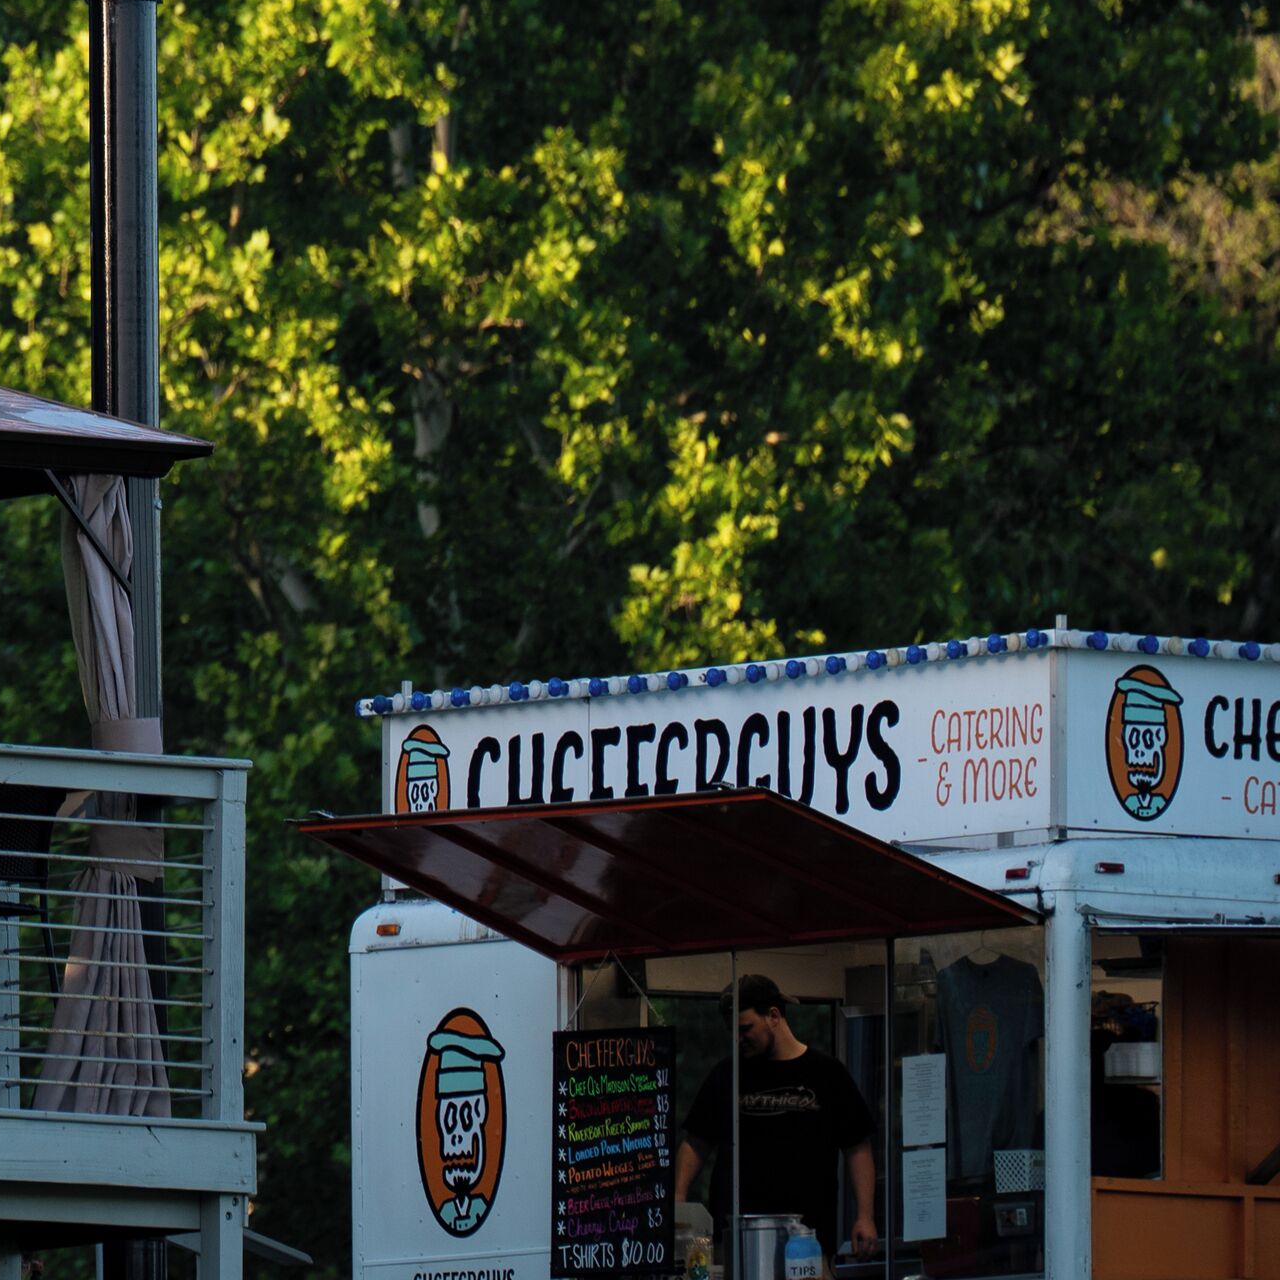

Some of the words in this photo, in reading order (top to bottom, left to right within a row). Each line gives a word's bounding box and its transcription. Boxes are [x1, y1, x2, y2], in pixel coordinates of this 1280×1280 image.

[931, 703, 1043, 755] CATERING
[936, 761, 952, 807] &
[962, 756, 1038, 805] MORE
[1244, 776, 1280, 816] CA
[566, 1038, 657, 1071] CHEFFERGUYS
[655, 1067, 669, 1088] $12
[656, 1093, 670, 1114] $13
[653, 1113, 668, 1131] $12
[653, 1132, 667, 1148] $10
[653, 1183, 666, 1200] $6
[647, 1206, 664, 1229] $3
[558, 1241, 615, 1269] T-SHIRTS
[790, 1266, 816, 1276] TIPS
